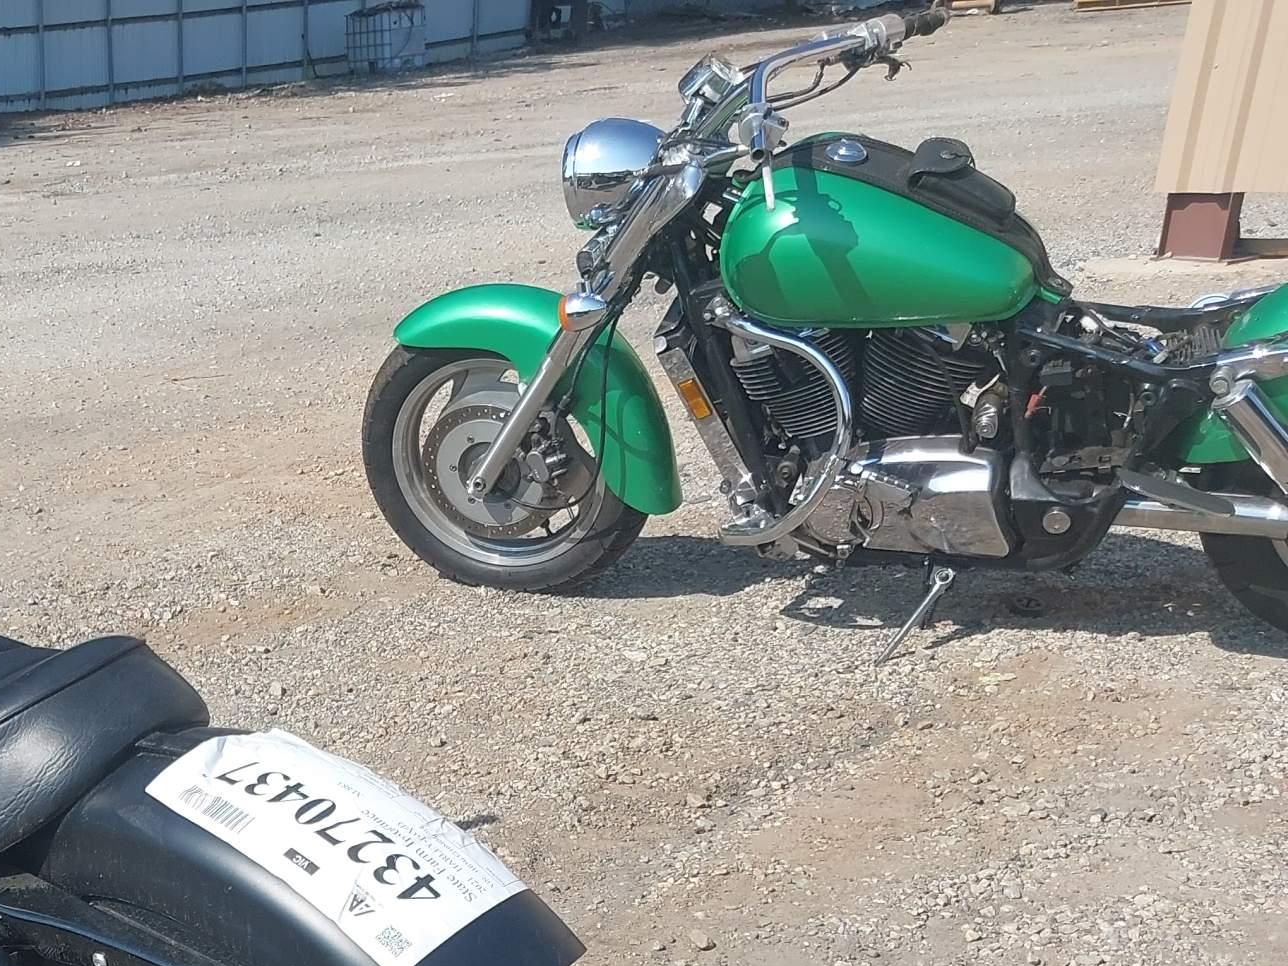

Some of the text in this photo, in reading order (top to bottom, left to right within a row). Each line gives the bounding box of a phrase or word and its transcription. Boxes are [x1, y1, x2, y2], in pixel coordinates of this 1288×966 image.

[214, 762, 441, 900] 43270437
[361, 809, 415, 848] Insurance
[292, 855, 310, 870] VIC
[415, 847, 447, 875] Farm
[446, 874, 478, 902] State
[467, 876, 487, 895] 2021
